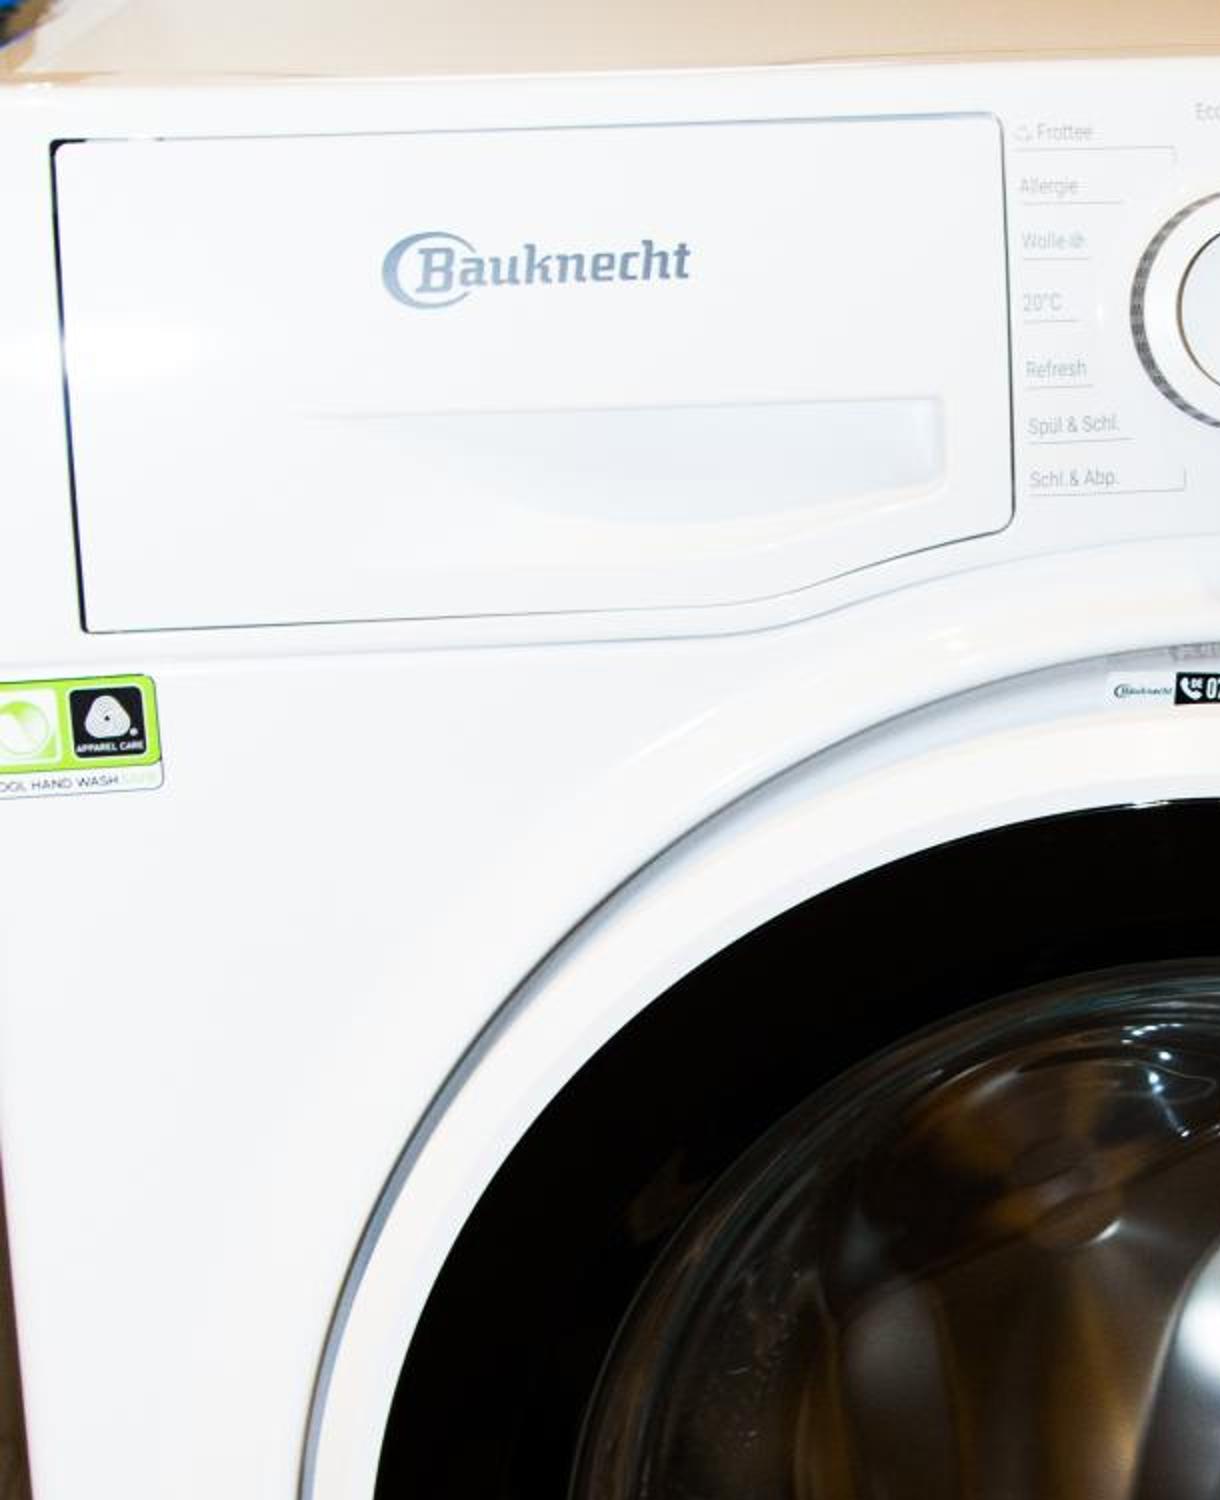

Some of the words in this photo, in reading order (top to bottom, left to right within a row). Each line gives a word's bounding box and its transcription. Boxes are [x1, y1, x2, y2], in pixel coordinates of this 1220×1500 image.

[1037, 123, 1093, 142] Frottee
[1019, 178, 1078, 197] Allergie
[382, 231, 691, 309] Bauknecht
[1026, 359, 1087, 378] Refresh
[1028, 417, 1062, 436] Spül
